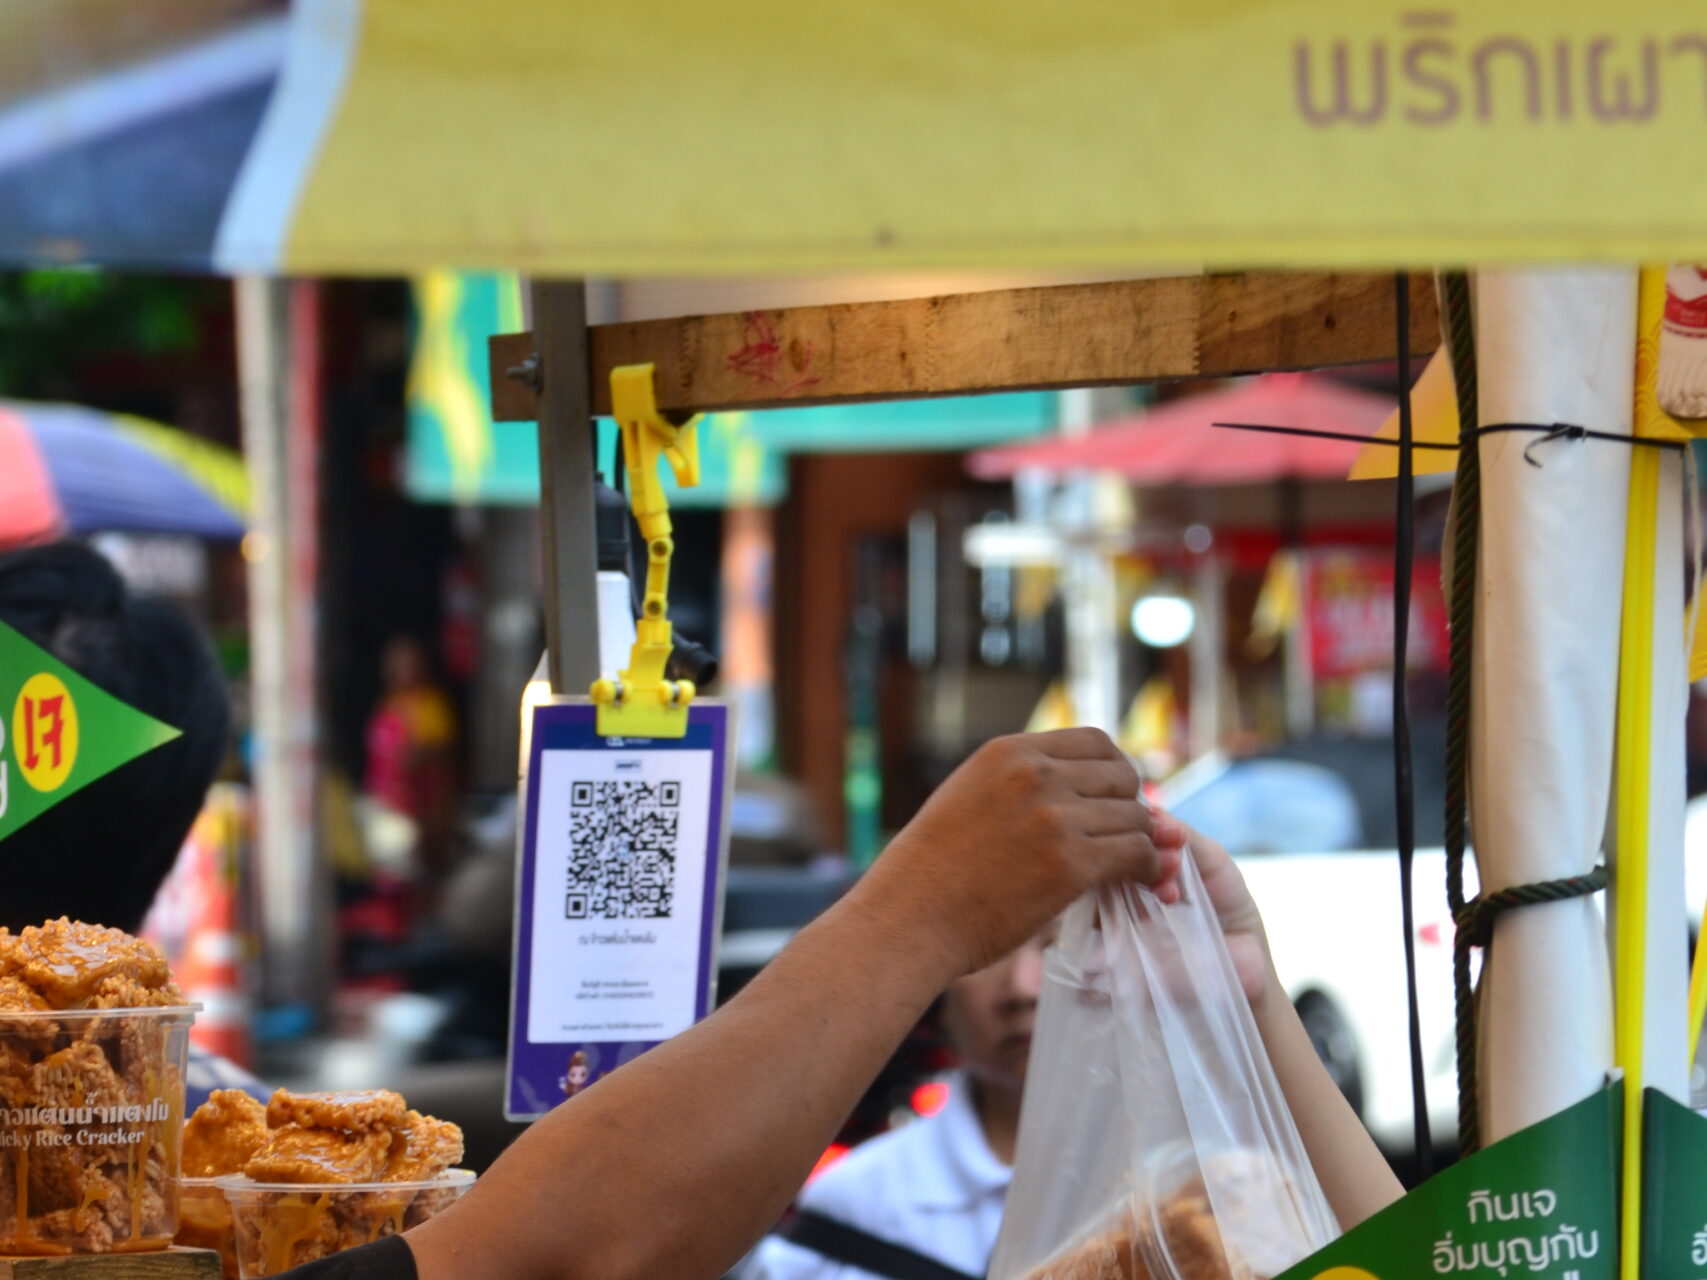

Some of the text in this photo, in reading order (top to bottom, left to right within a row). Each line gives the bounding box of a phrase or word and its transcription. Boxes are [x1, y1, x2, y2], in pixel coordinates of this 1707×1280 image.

[36, 1129, 72, 1147] Rice
[76, 1127, 144, 1146] Cracker
[1467, 1188, 1557, 1224] กินเจ
[1433, 1224, 1599, 1277] อิ่มบุญกับ
